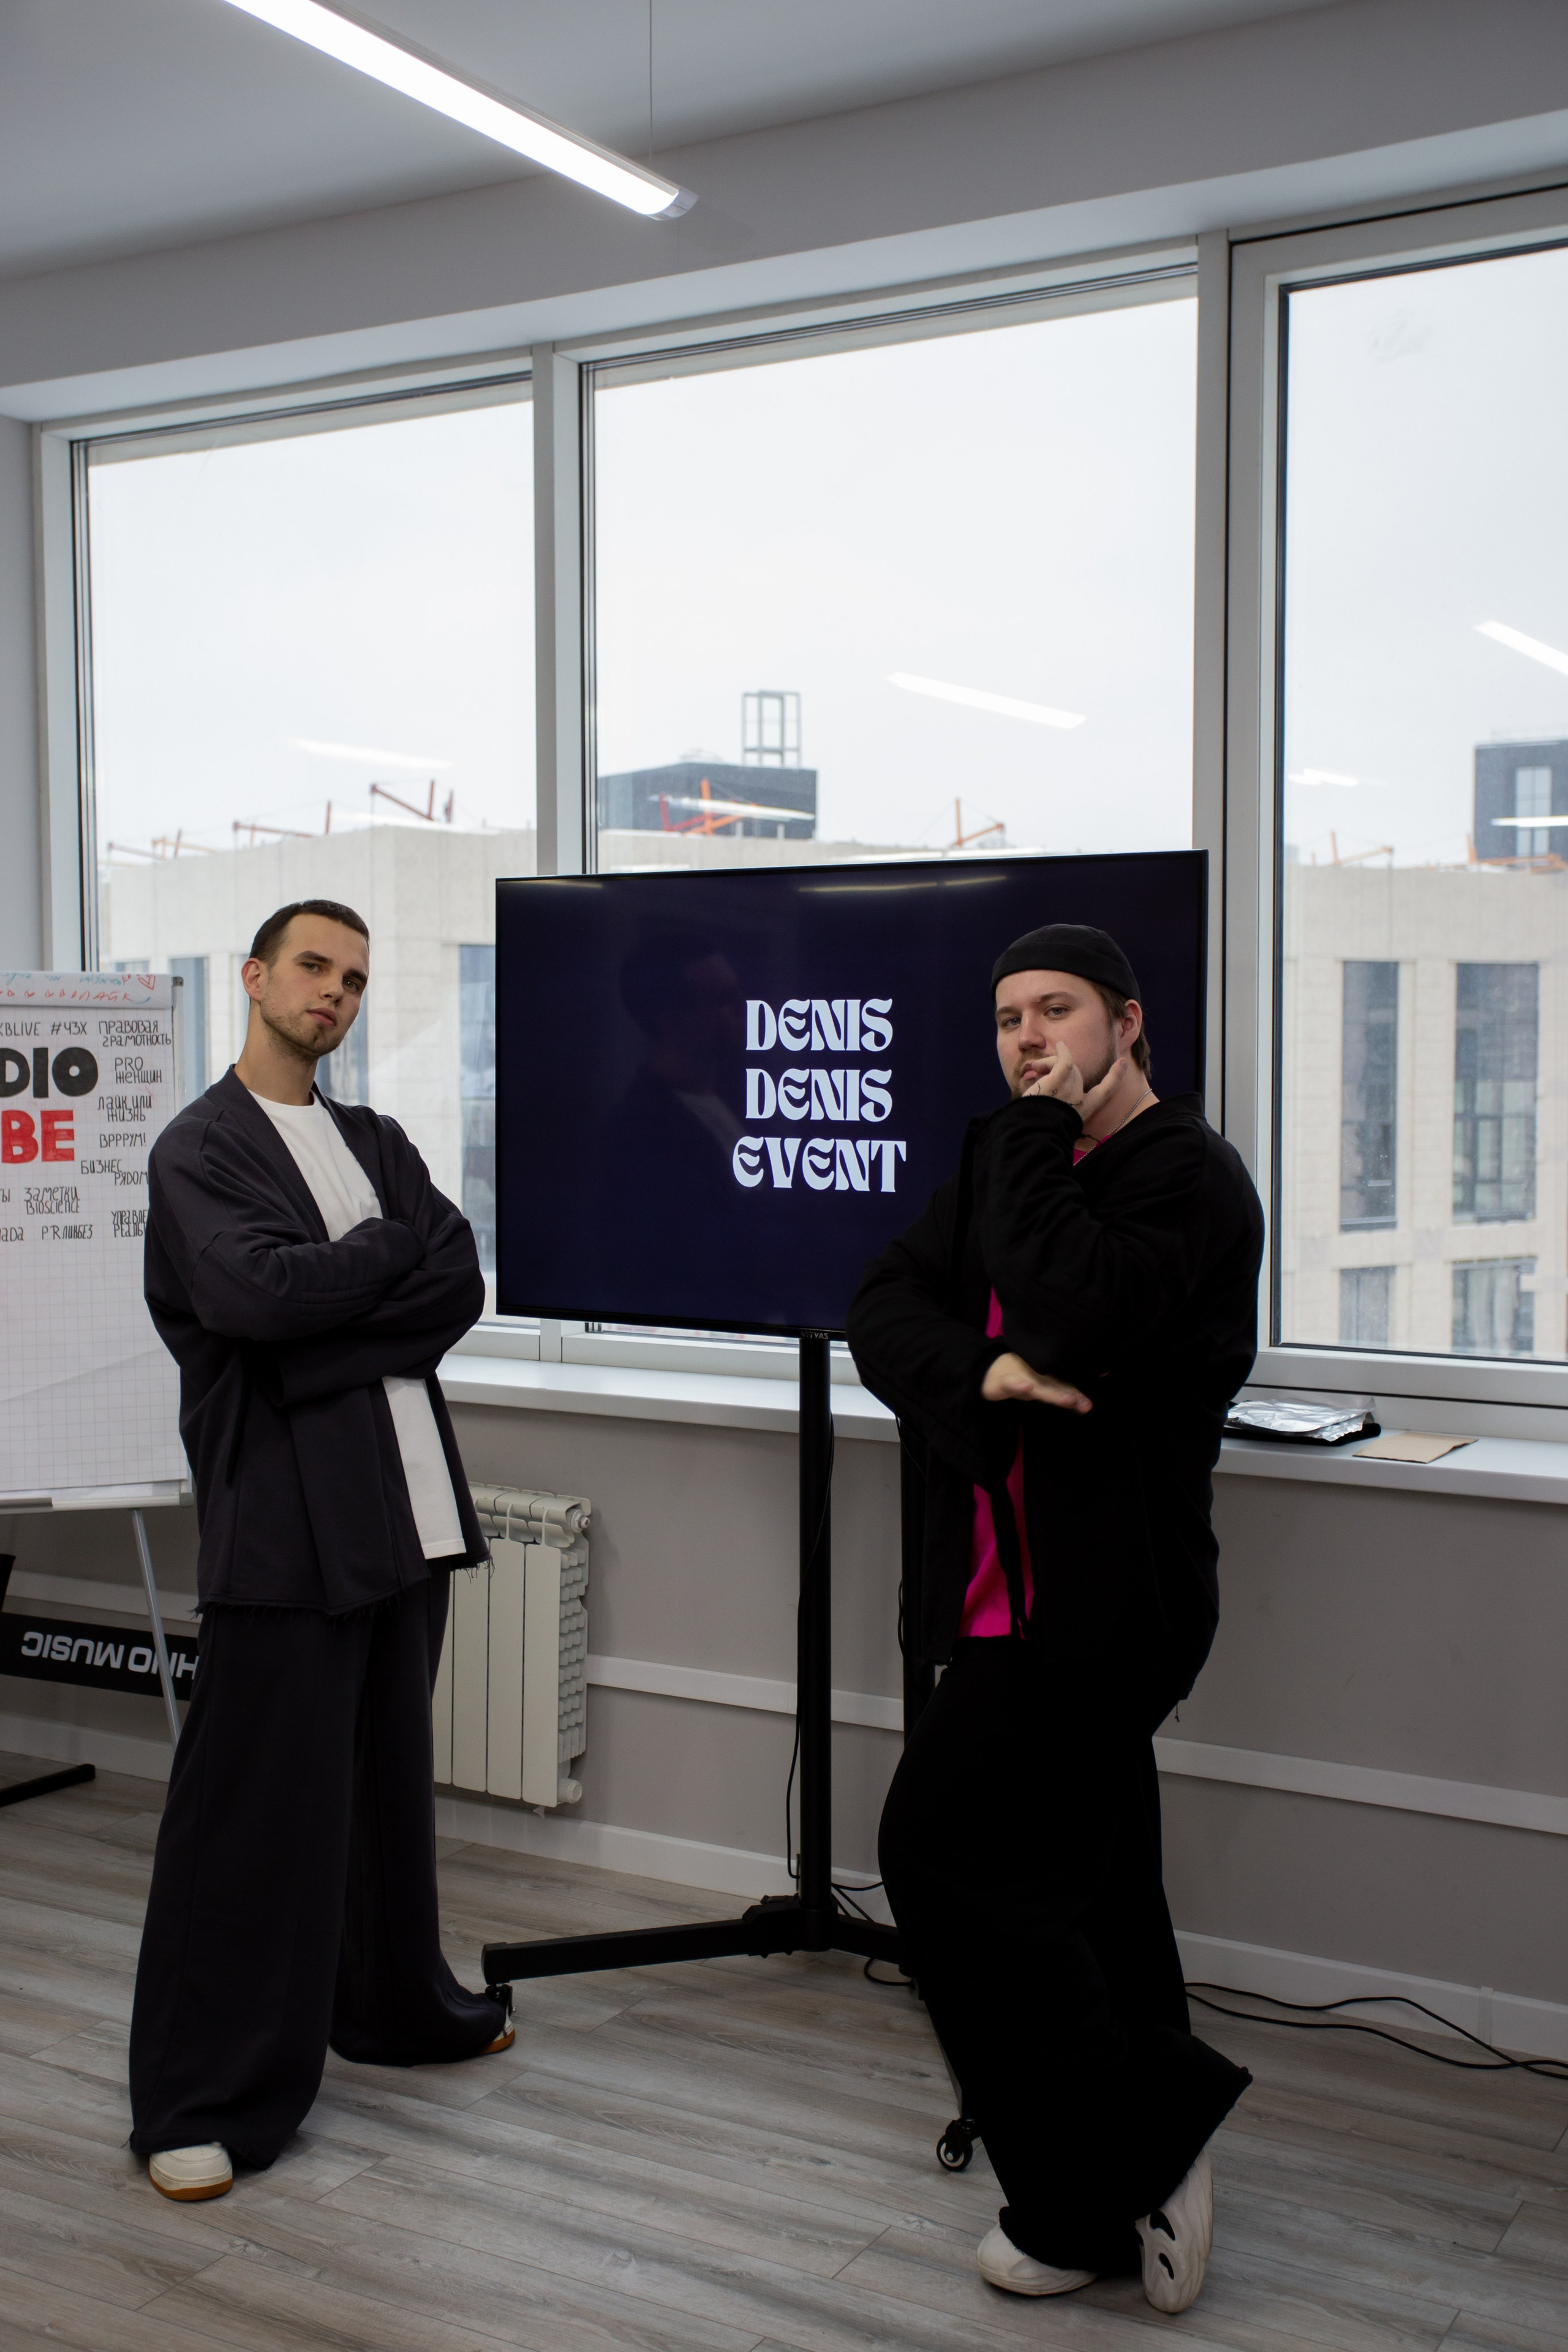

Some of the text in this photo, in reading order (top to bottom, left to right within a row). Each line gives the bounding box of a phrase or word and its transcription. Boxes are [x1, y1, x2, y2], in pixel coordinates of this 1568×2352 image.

[745, 998, 893, 1052] DENIS
[0, 1047, 98, 1098] DIO
[745, 1069, 892, 1122] DENIS
[1, 1109, 75, 1164] BE
[733, 1136, 907, 1193] EVENT
[21, 1631, 124, 1669] MUSIC
